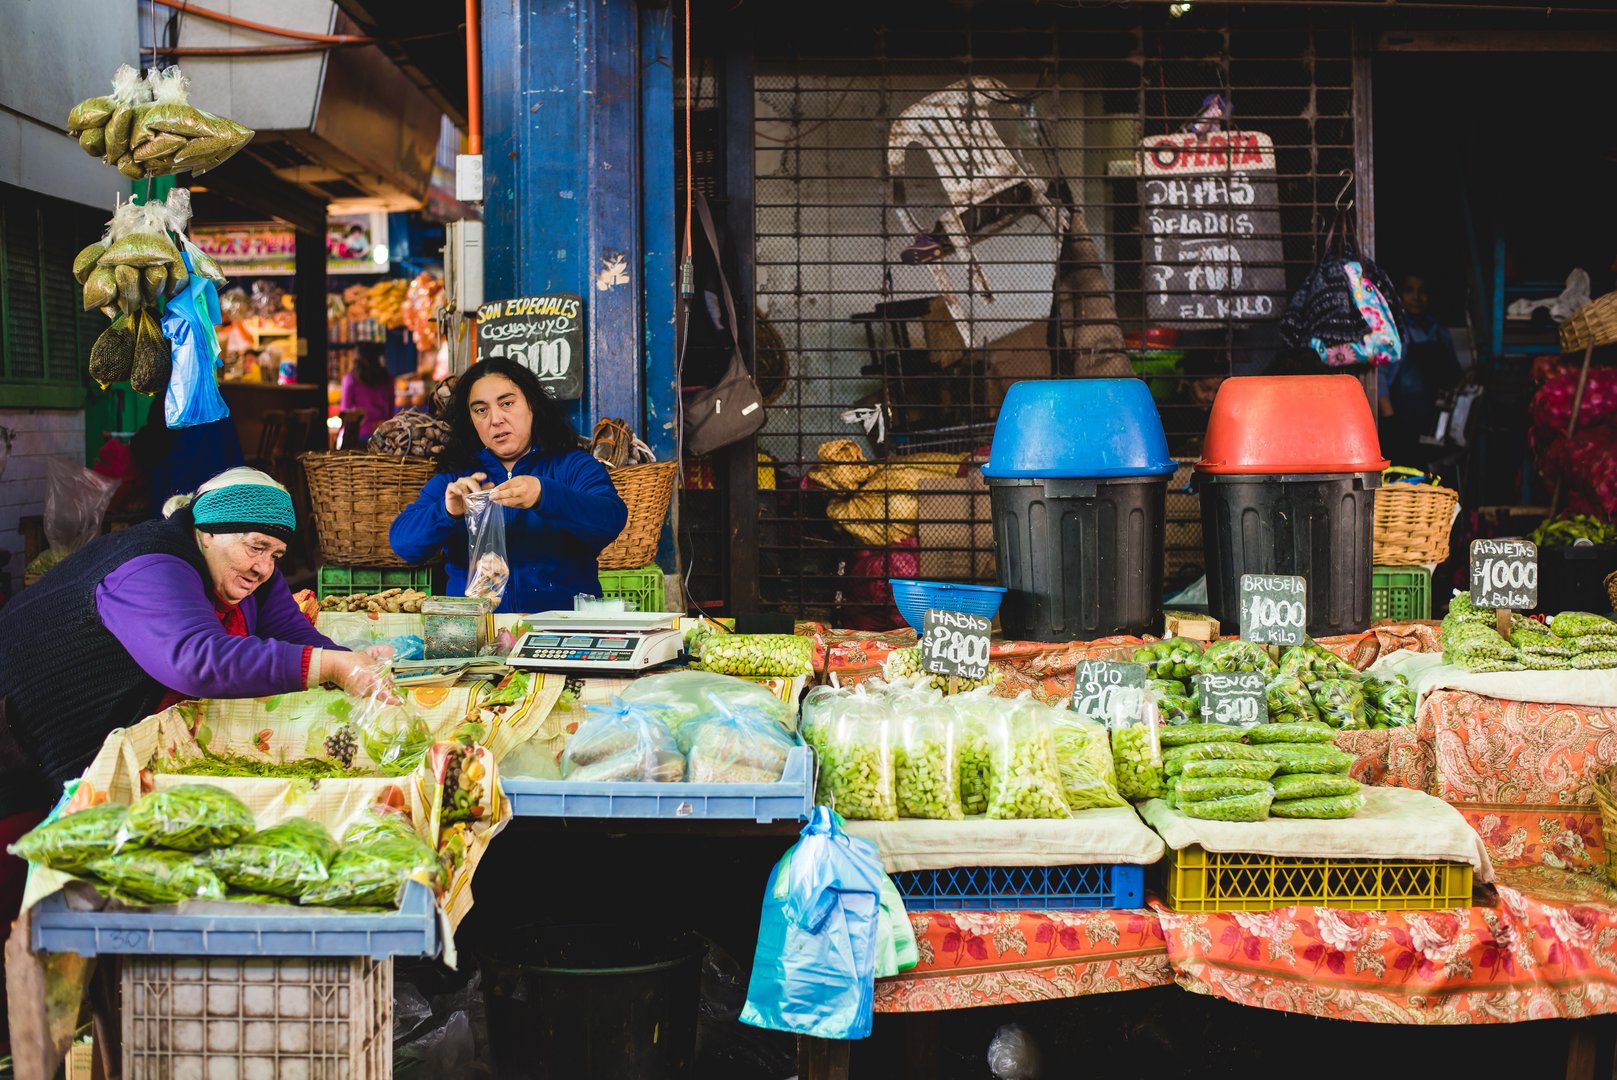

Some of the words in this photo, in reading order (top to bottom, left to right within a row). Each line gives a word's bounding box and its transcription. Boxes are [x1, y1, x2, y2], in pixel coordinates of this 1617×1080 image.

[1151, 134, 1262, 170] OFERTA
[476, 303, 502, 324] SON
[505, 297, 580, 319] ESPECIALES
[1473, 540, 1535, 557] ARVEJAS
[1476, 596, 1488, 607] LA
[931, 609, 988, 631] HABAS
[929, 660, 950, 673] EL
[957, 663, 986, 680] KILO
